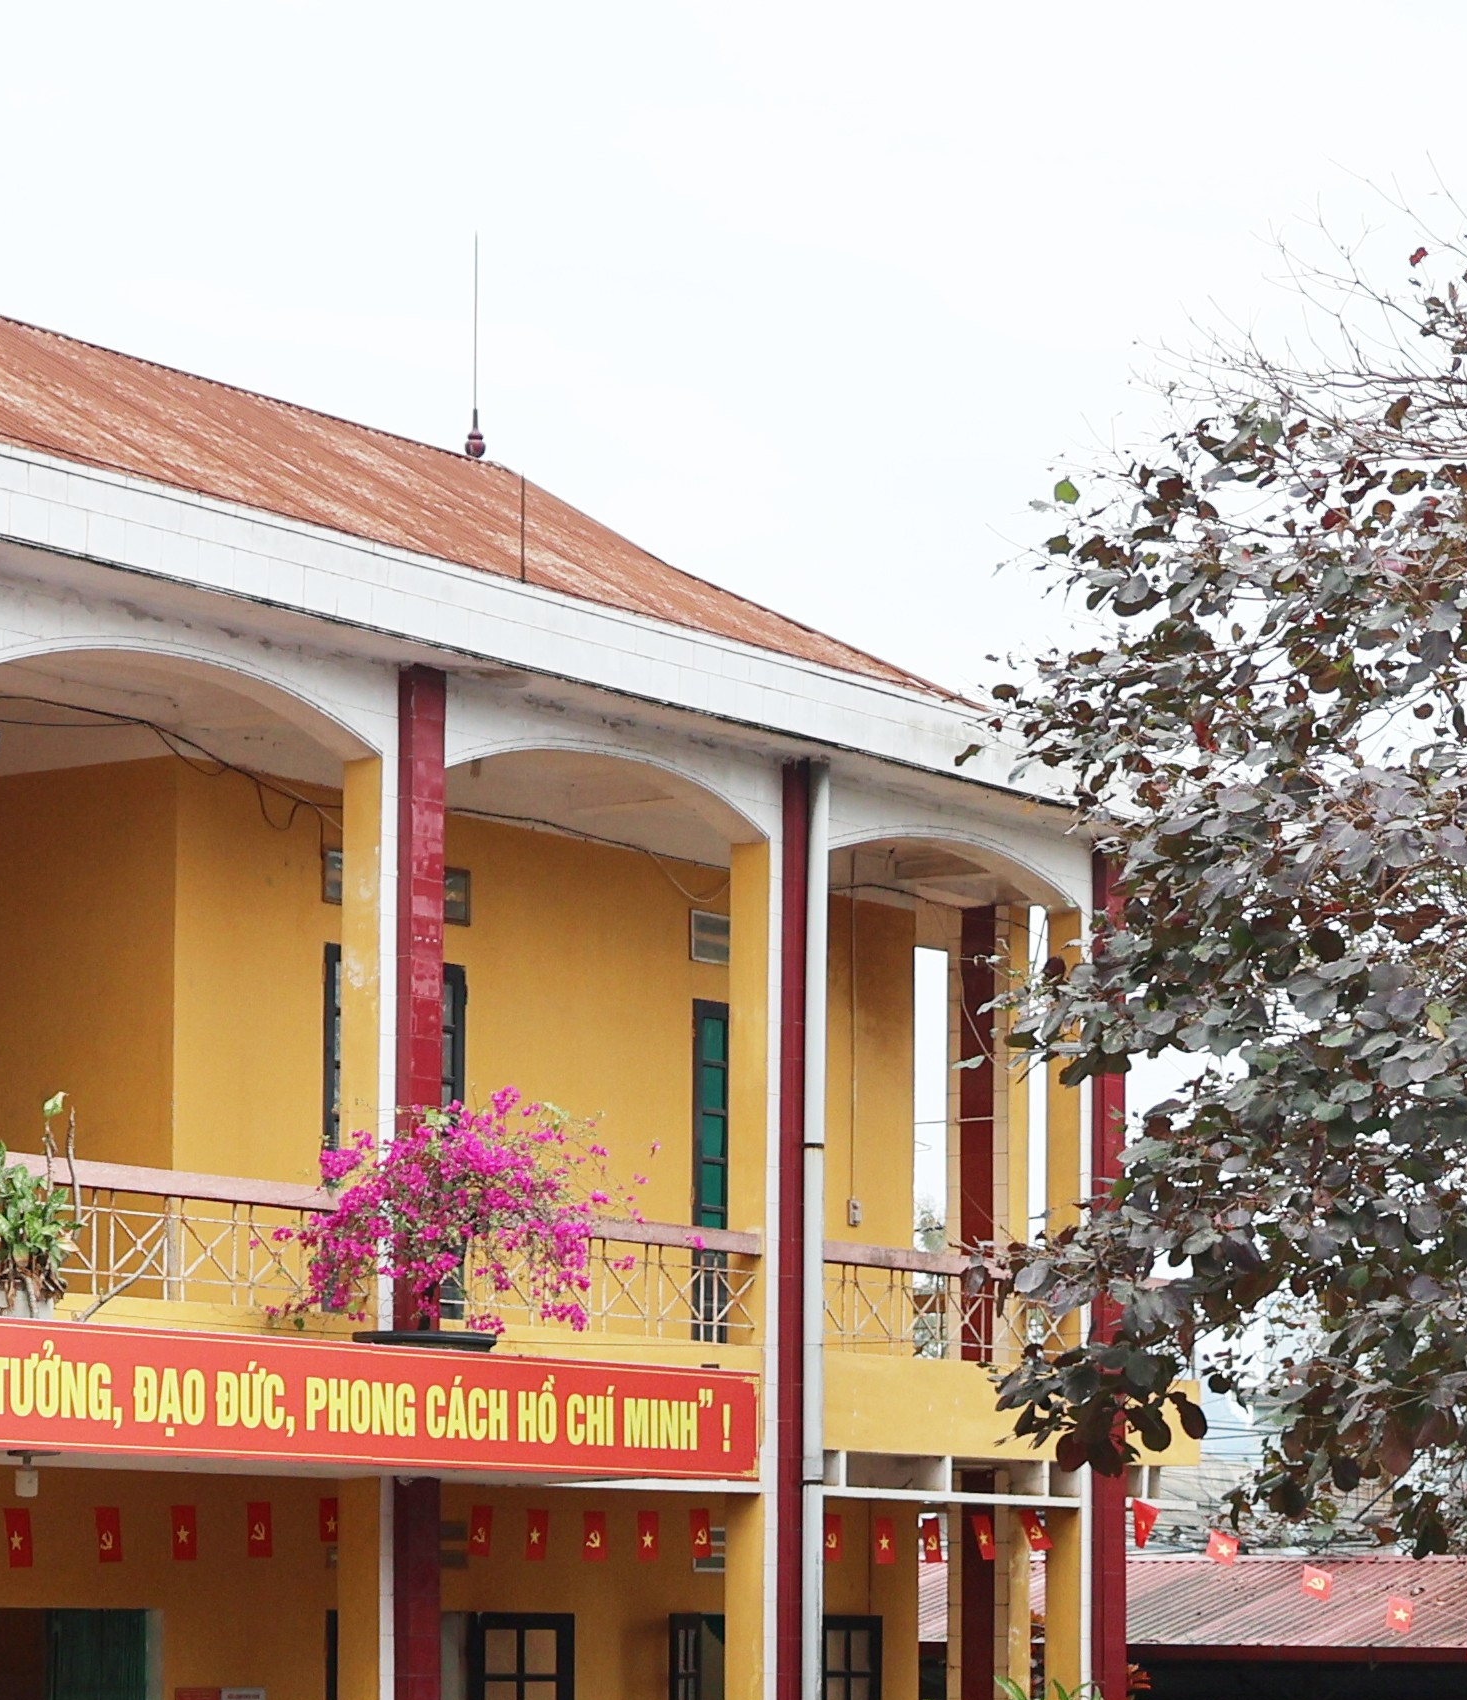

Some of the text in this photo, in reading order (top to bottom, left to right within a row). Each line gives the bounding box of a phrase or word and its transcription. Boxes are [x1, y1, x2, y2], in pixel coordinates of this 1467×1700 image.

[133, 1365, 206, 1437] ĐẠO
[215, 1360, 295, 1438] ĐỨC,
[306, 1376, 417, 1439] PHONG
[425, 1375, 509, 1443] CÁCH
[517, 1374, 557, 1446] HỒ
[566, 1386, 616, 1448] CHÍ
